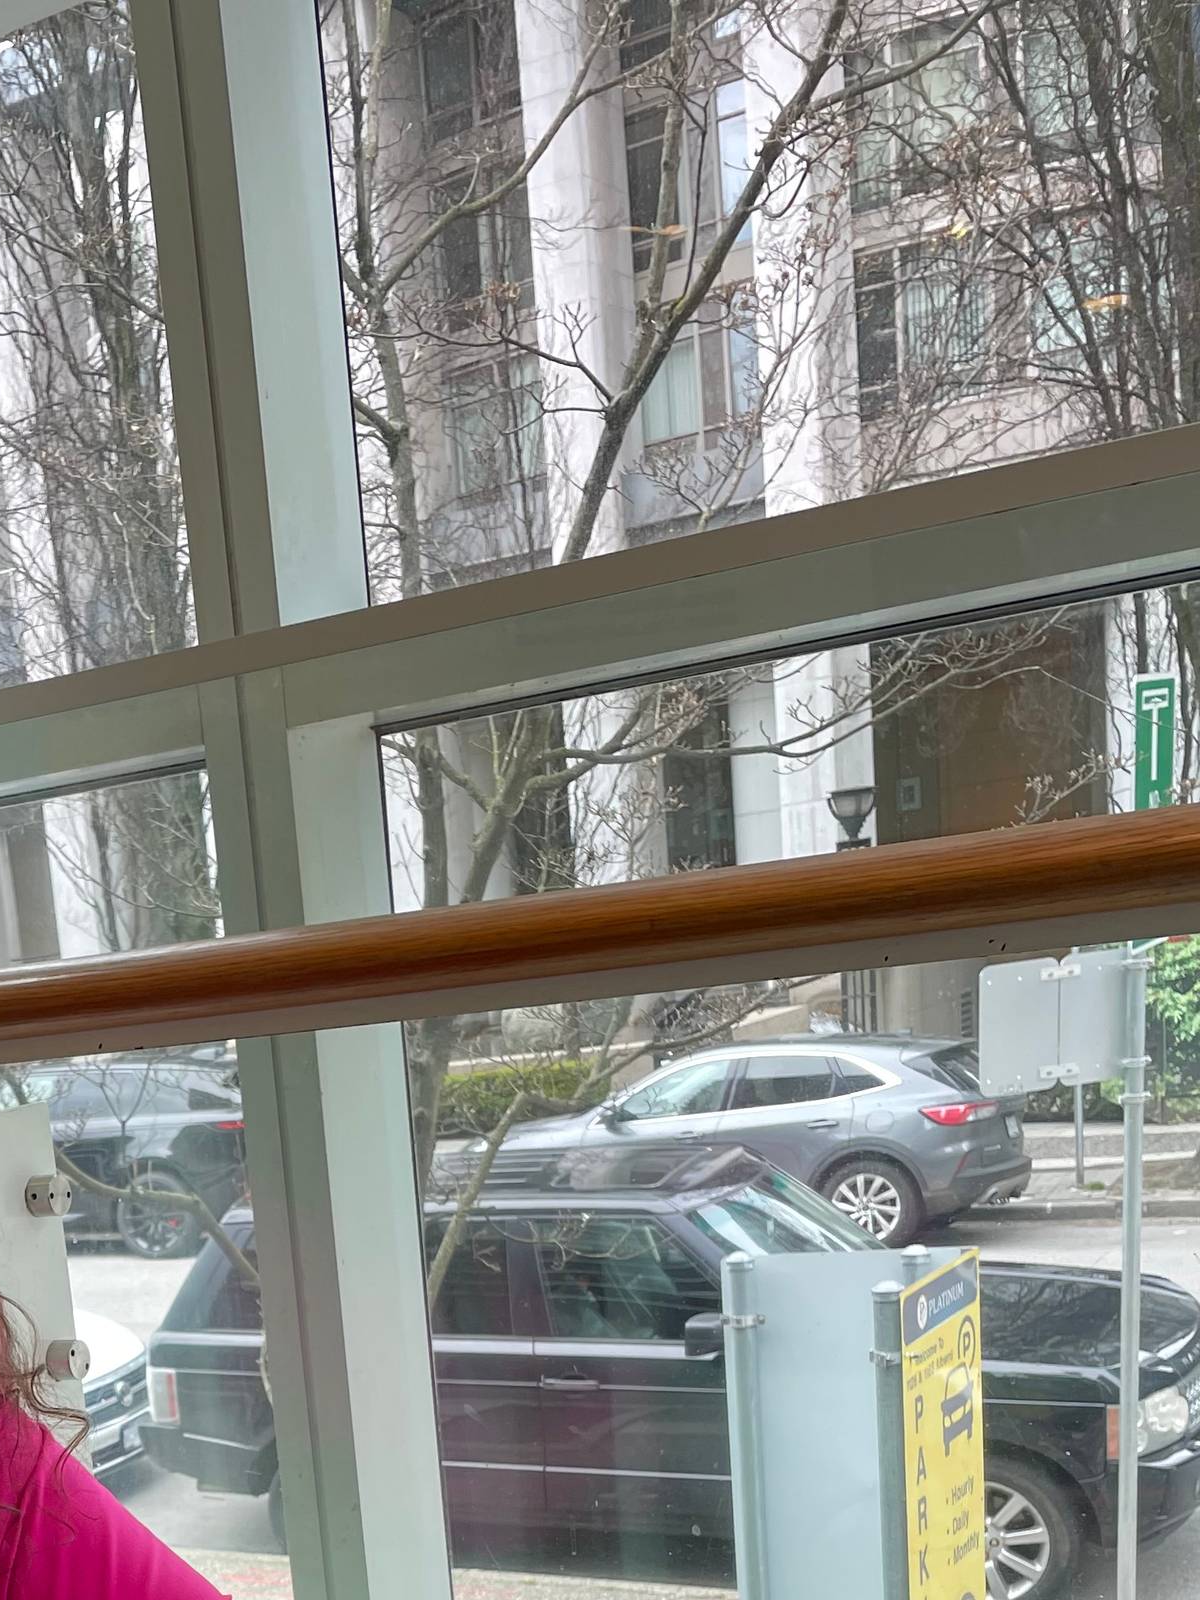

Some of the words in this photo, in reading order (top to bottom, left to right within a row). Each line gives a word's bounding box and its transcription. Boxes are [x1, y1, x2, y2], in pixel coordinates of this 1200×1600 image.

[928, 1281, 964, 1318] PLATINUM
[951, 1476, 974, 1505] Hourly
[952, 1509, 969, 1535] Daily
[953, 1532, 979, 1567] Monthly
